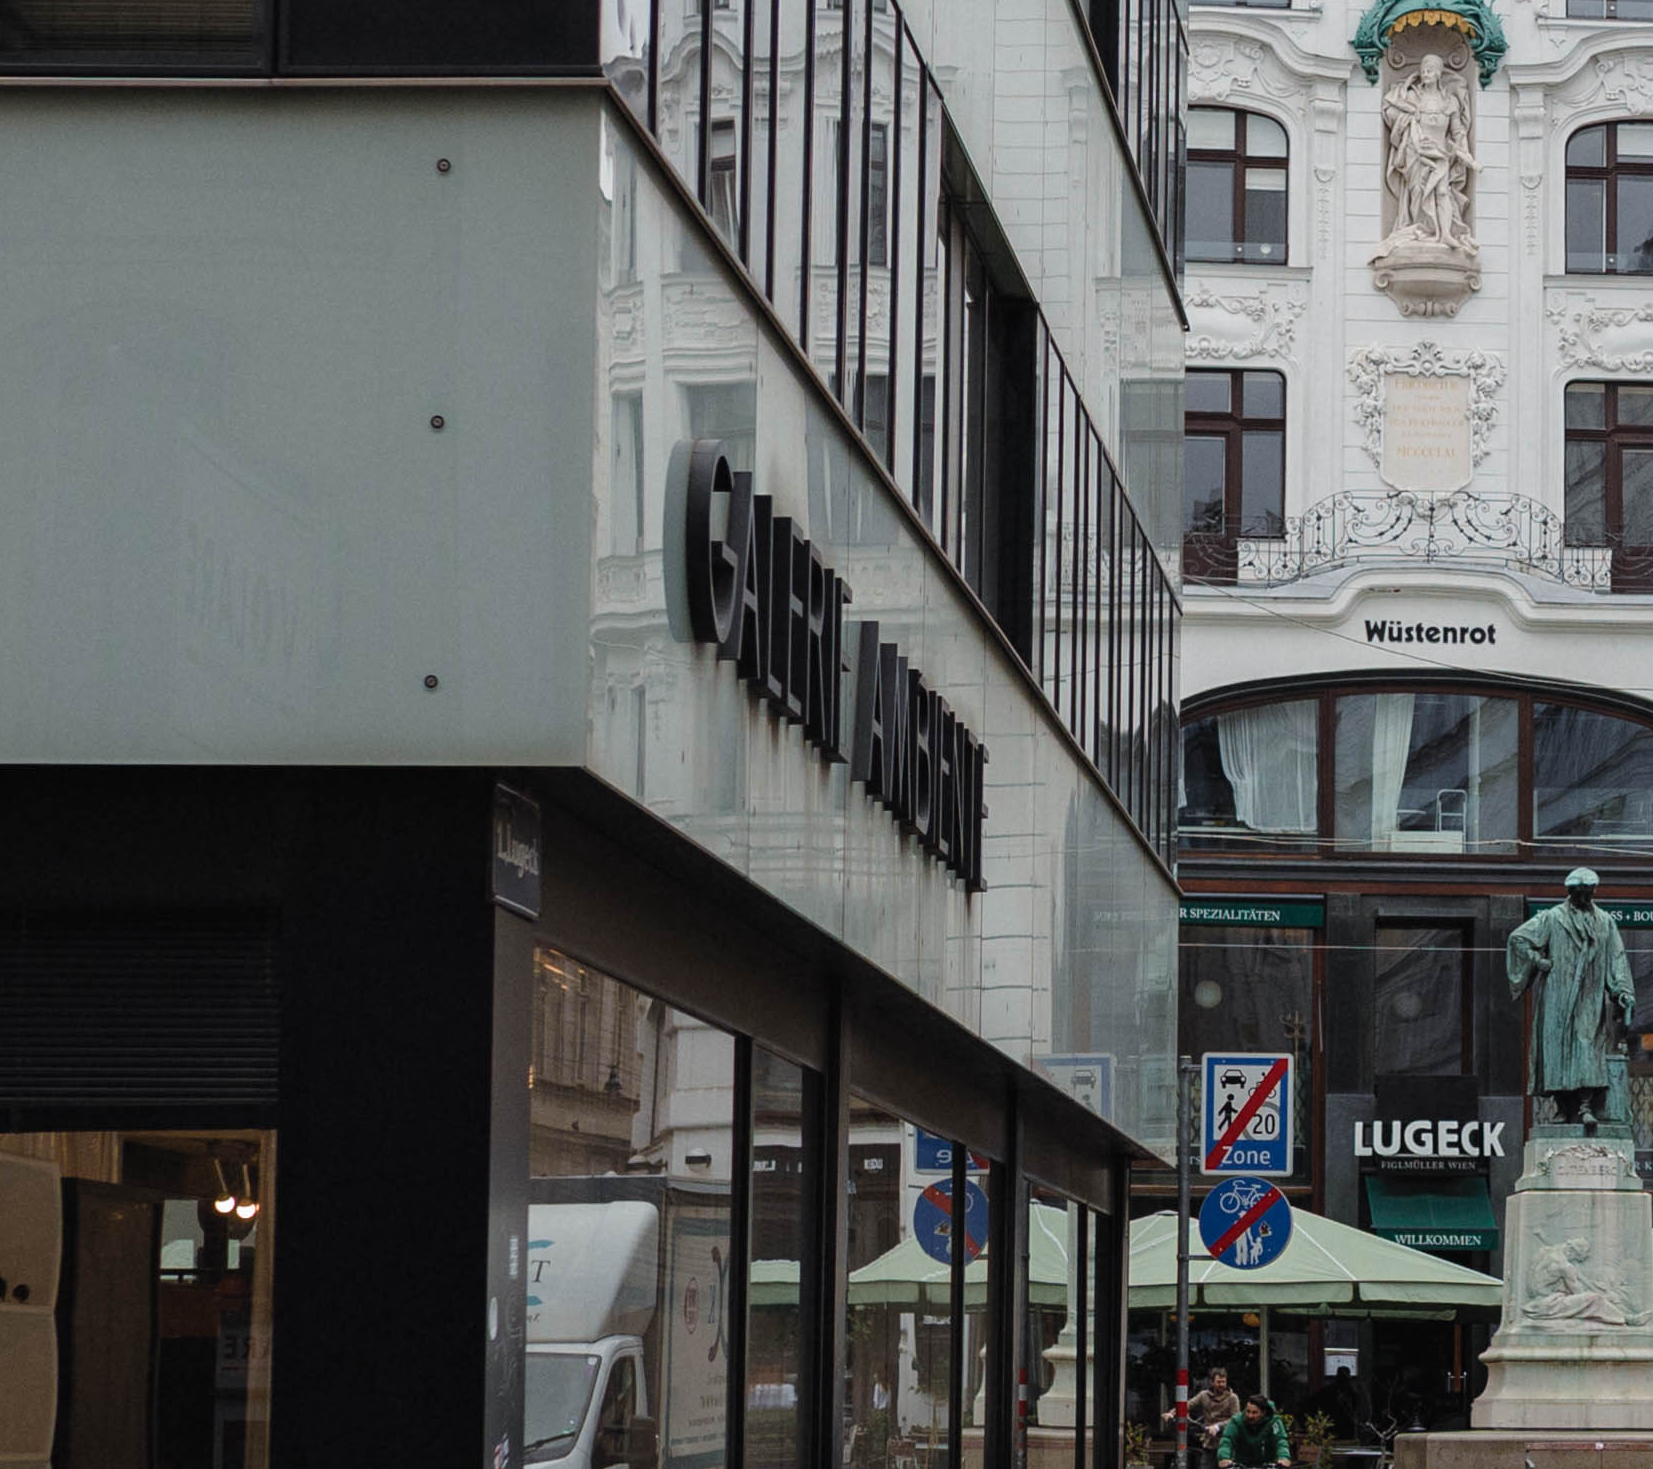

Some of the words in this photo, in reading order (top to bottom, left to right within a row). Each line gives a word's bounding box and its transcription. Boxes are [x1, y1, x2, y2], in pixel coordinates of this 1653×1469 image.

[1364, 619, 1497, 645] Wüstenrot
[1190, 907, 1281, 922] SPEZIALITÄTEN
[1252, 1113, 1276, 1135] 20
[1354, 1119, 1506, 1158] LUGECK
[1220, 1145, 1272, 1165] Zone
[1381, 1159, 1445, 1171] FIGLMÜLLER
[1448, 1160, 1476, 1171] WIEN
[1395, 1233, 1482, 1247] WILLKOMMEN
